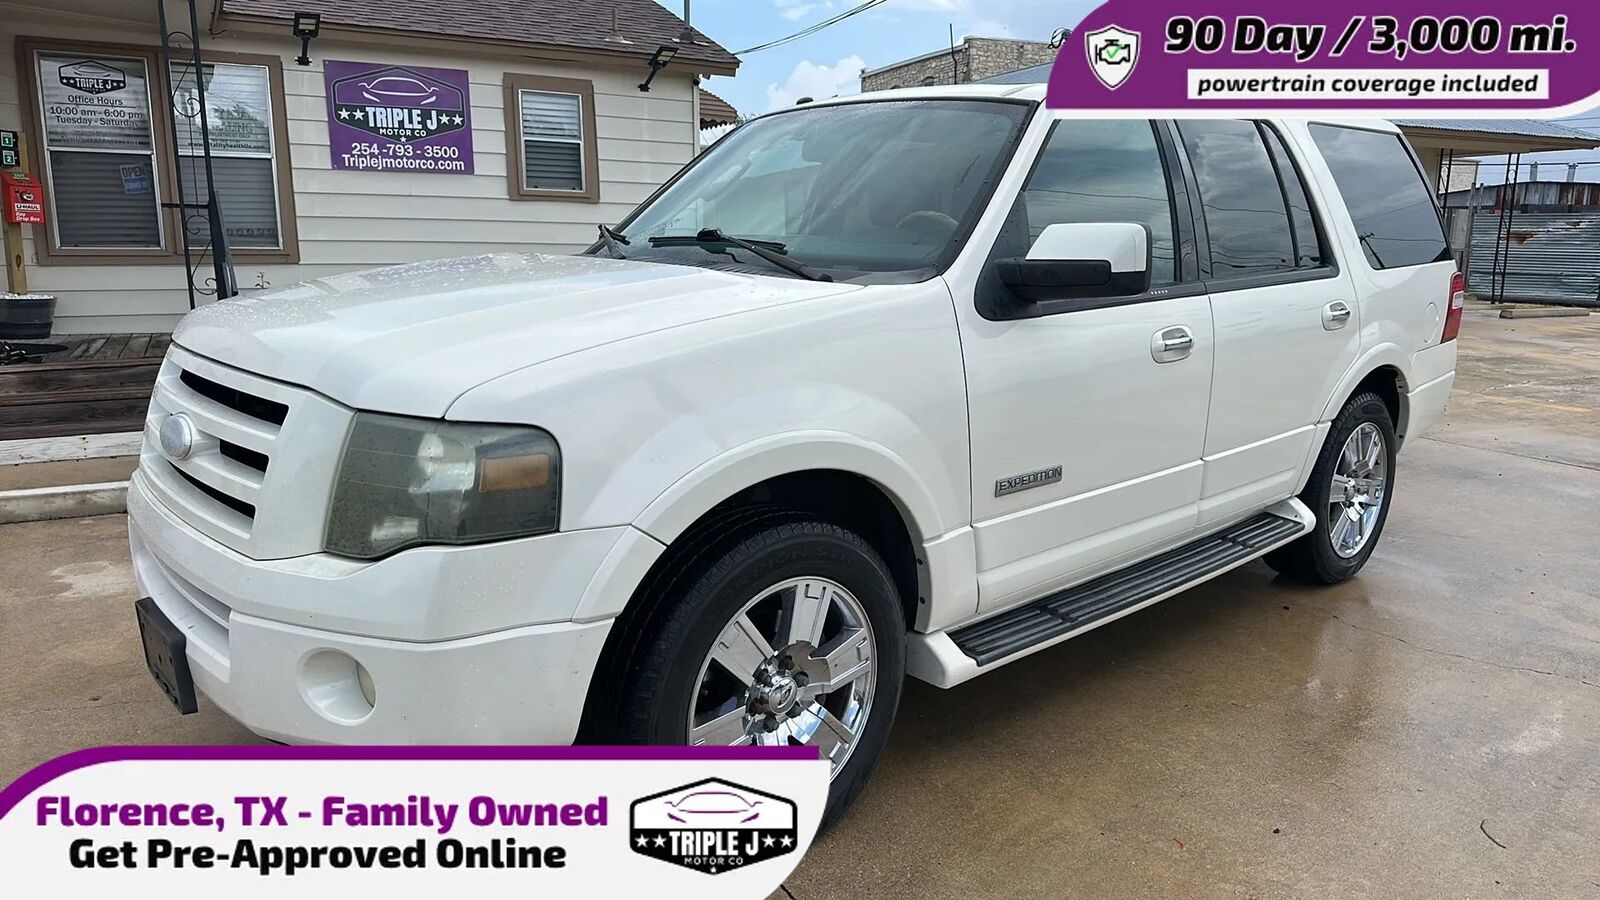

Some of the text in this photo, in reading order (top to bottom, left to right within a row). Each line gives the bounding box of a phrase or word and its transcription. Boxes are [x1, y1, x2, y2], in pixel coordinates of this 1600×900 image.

[75, 77, 104, 89] TRIPLE
[67, 94, 123, 105] Office Hours
[49, 106, 78, 116] 10:00
[103, 108, 126, 118] 6:00
[128, 112, 143, 120] pm
[365, 106, 438, 130] TRIPLE J
[54, 115, 93, 126] Tuesday
[99, 117, 139, 128] Saturday
[379, 128, 427, 137] MOTOR CO
[342, 154, 465, 171] Triplejmotorco.com
[121, 166, 146, 177] OPEN
[998, 466, 1063, 492] EXPEDITION
